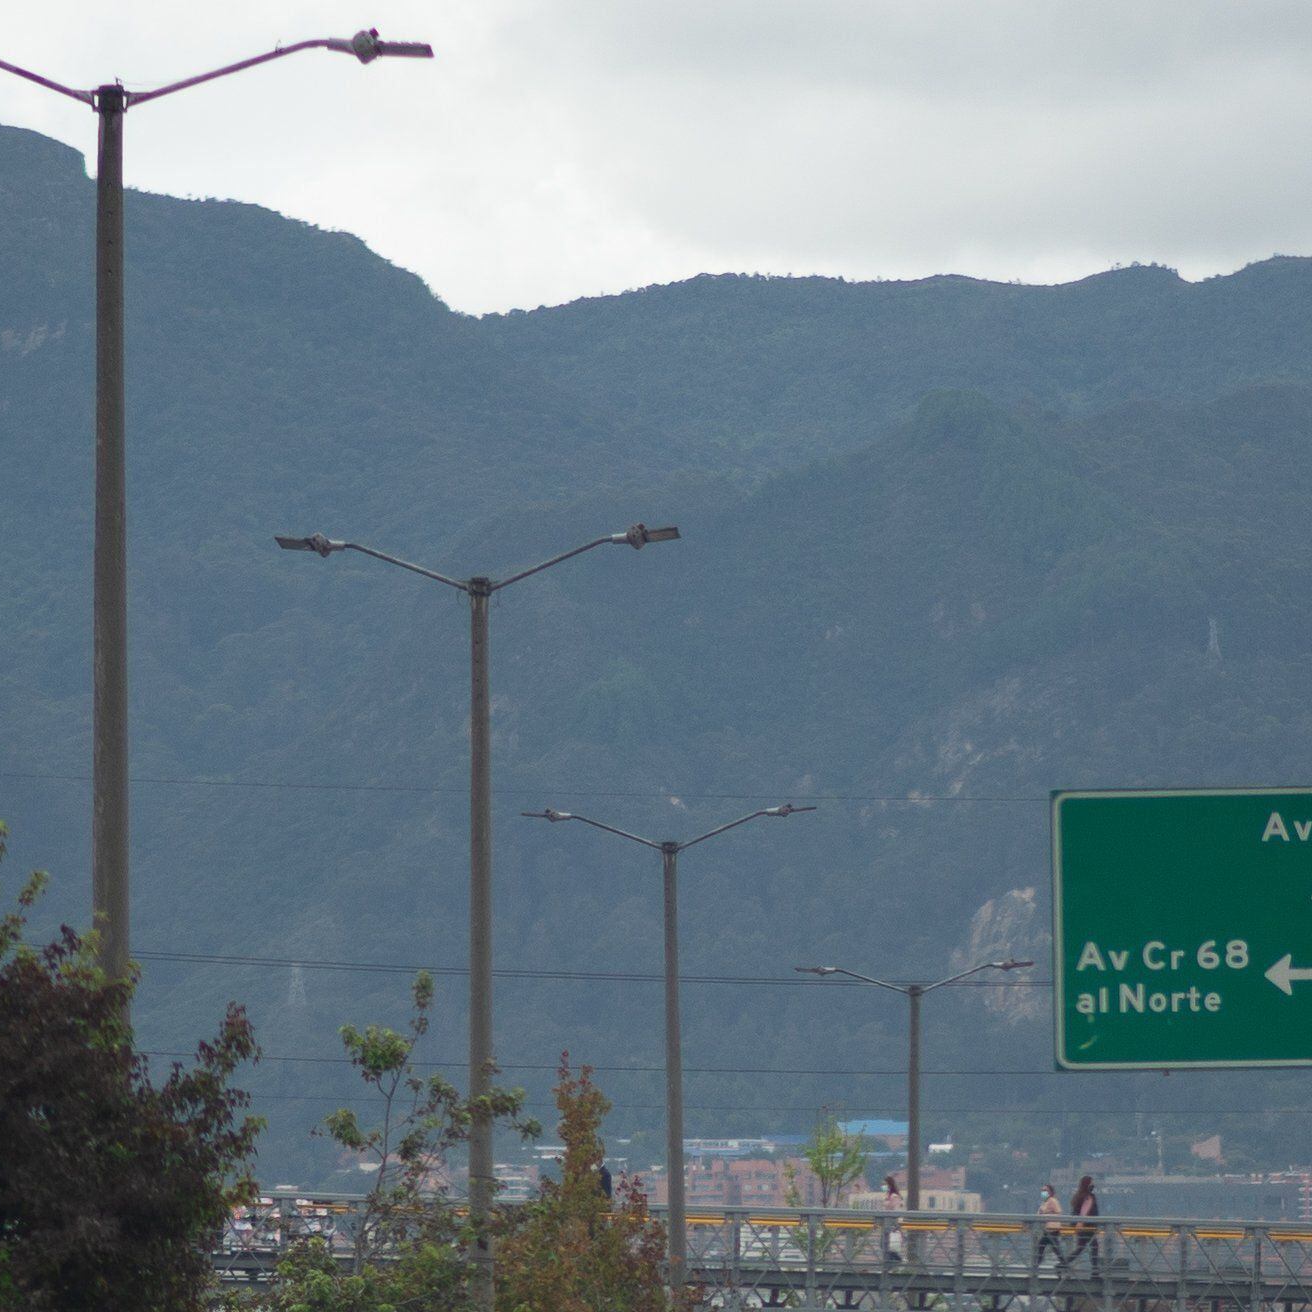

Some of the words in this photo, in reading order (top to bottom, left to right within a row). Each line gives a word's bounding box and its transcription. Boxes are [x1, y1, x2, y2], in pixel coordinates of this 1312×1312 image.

[1261, 811, 1312, 842] Av
[1075, 941, 1129, 971] Av
[1142, 941, 1185, 971] Cr
[1196, 939, 1250, 970] 68
[1075, 986, 1109, 1014] al
[1118, 983, 1222, 1013] Norte
